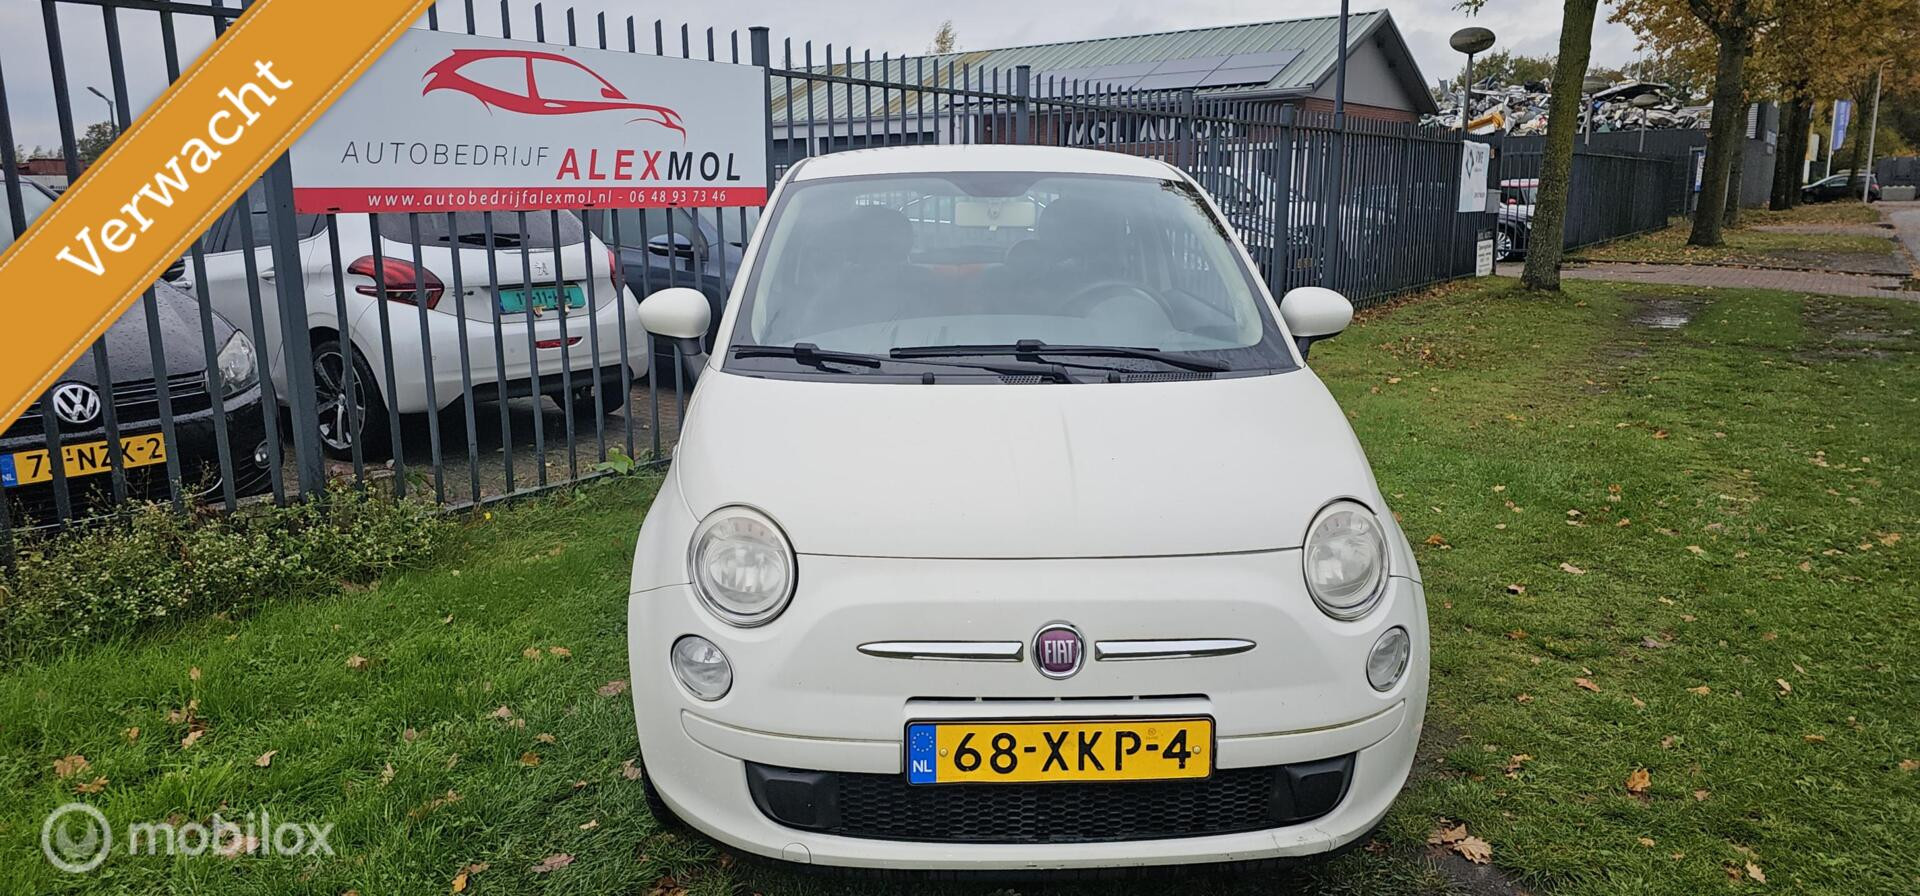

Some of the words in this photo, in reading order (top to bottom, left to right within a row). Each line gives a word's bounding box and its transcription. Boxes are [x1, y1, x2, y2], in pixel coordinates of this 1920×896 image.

[341, 141, 549, 167] AUTOBEDRIJF
[368, 189, 612, 208] www.autobedrijfalexmol.nl
[629, 190, 645, 203] 06
[651, 190, 666, 203] 48
[672, 190, 686, 203] 93
[692, 190, 706, 203] 73
[712, 190, 726, 203] 46
[1044, 640, 1074, 664] FIAT
[912, 760, 933, 773] NL
[953, 729, 1192, 774] 68-XKP-4
